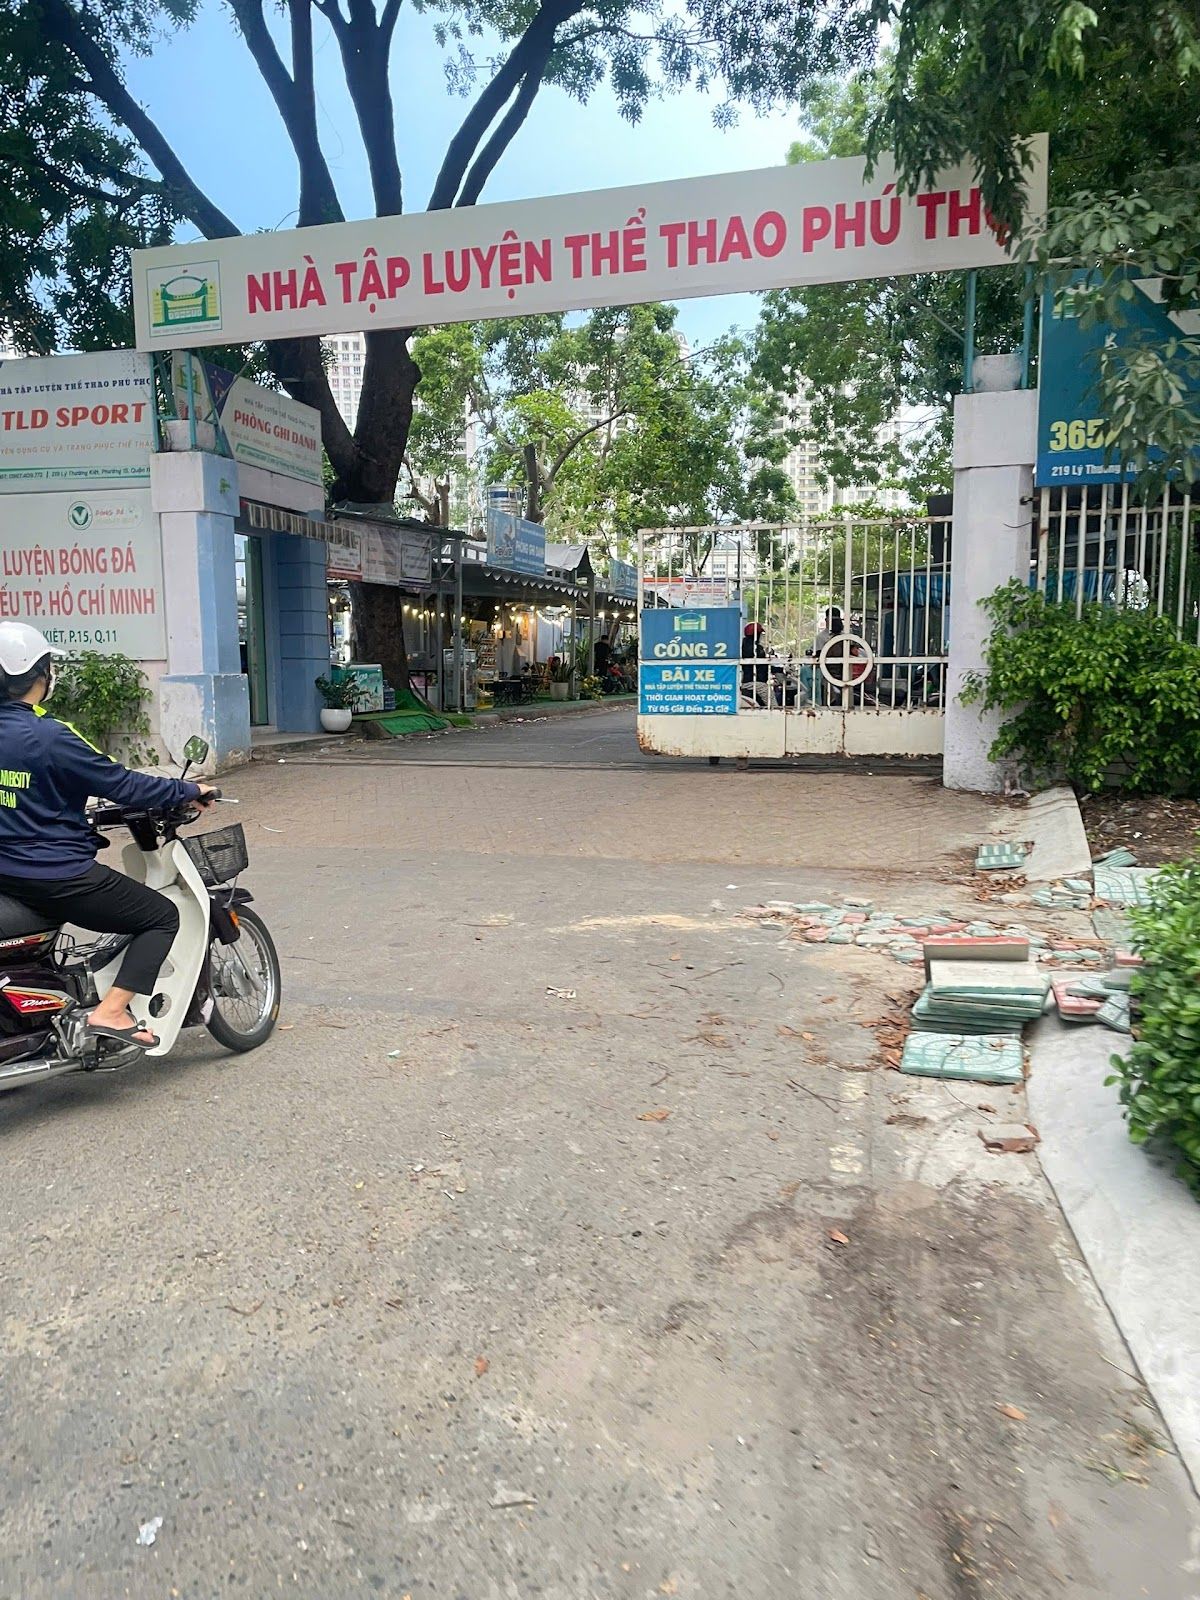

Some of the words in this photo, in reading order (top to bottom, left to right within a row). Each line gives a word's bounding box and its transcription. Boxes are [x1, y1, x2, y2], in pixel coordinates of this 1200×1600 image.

[247, 255, 327, 314] NHÀ
[334, 247, 411, 313] TẬP
[423, 230, 552, 299] LUYỆN
[564, 207, 647, 279] THỂ
[659, 210, 787, 268] THAO
[802, 183, 901, 253] PHÚ
[85, 380, 109, 389] THAO
[2, 409, 49, 431] TLD
[56, 402, 147, 428] SPORT
[234, 409, 271, 434] PHÒNG
[273, 424, 290, 441] GHI
[291, 432, 317, 451] DANH
[1051, 465, 1070, 477] 219
[1072, 464, 1084, 477] Lý
[3, 544, 55, 583] LUYỆN
[59, 542, 107, 575] BÓNG
[111, 541, 136, 573] ĐÁ
[23, 591, 46, 616] TP.
[49, 582, 74, 616] HỒ
[77, 583, 105, 616] CHÍ
[110, 588, 155, 615] MINH
[69, 630, 92, 645] P.15,
[95, 629, 117, 644] Q.11
[653, 635, 708, 658] CỔNG
[714, 642, 727, 657] 2
[661, 666, 690, 682] BÃI
[694, 669, 716, 682] XE
[664, 694, 683, 702] GIAN
[684, 694, 705, 704] HOẠT
[704, 705, 715, 713] 22
